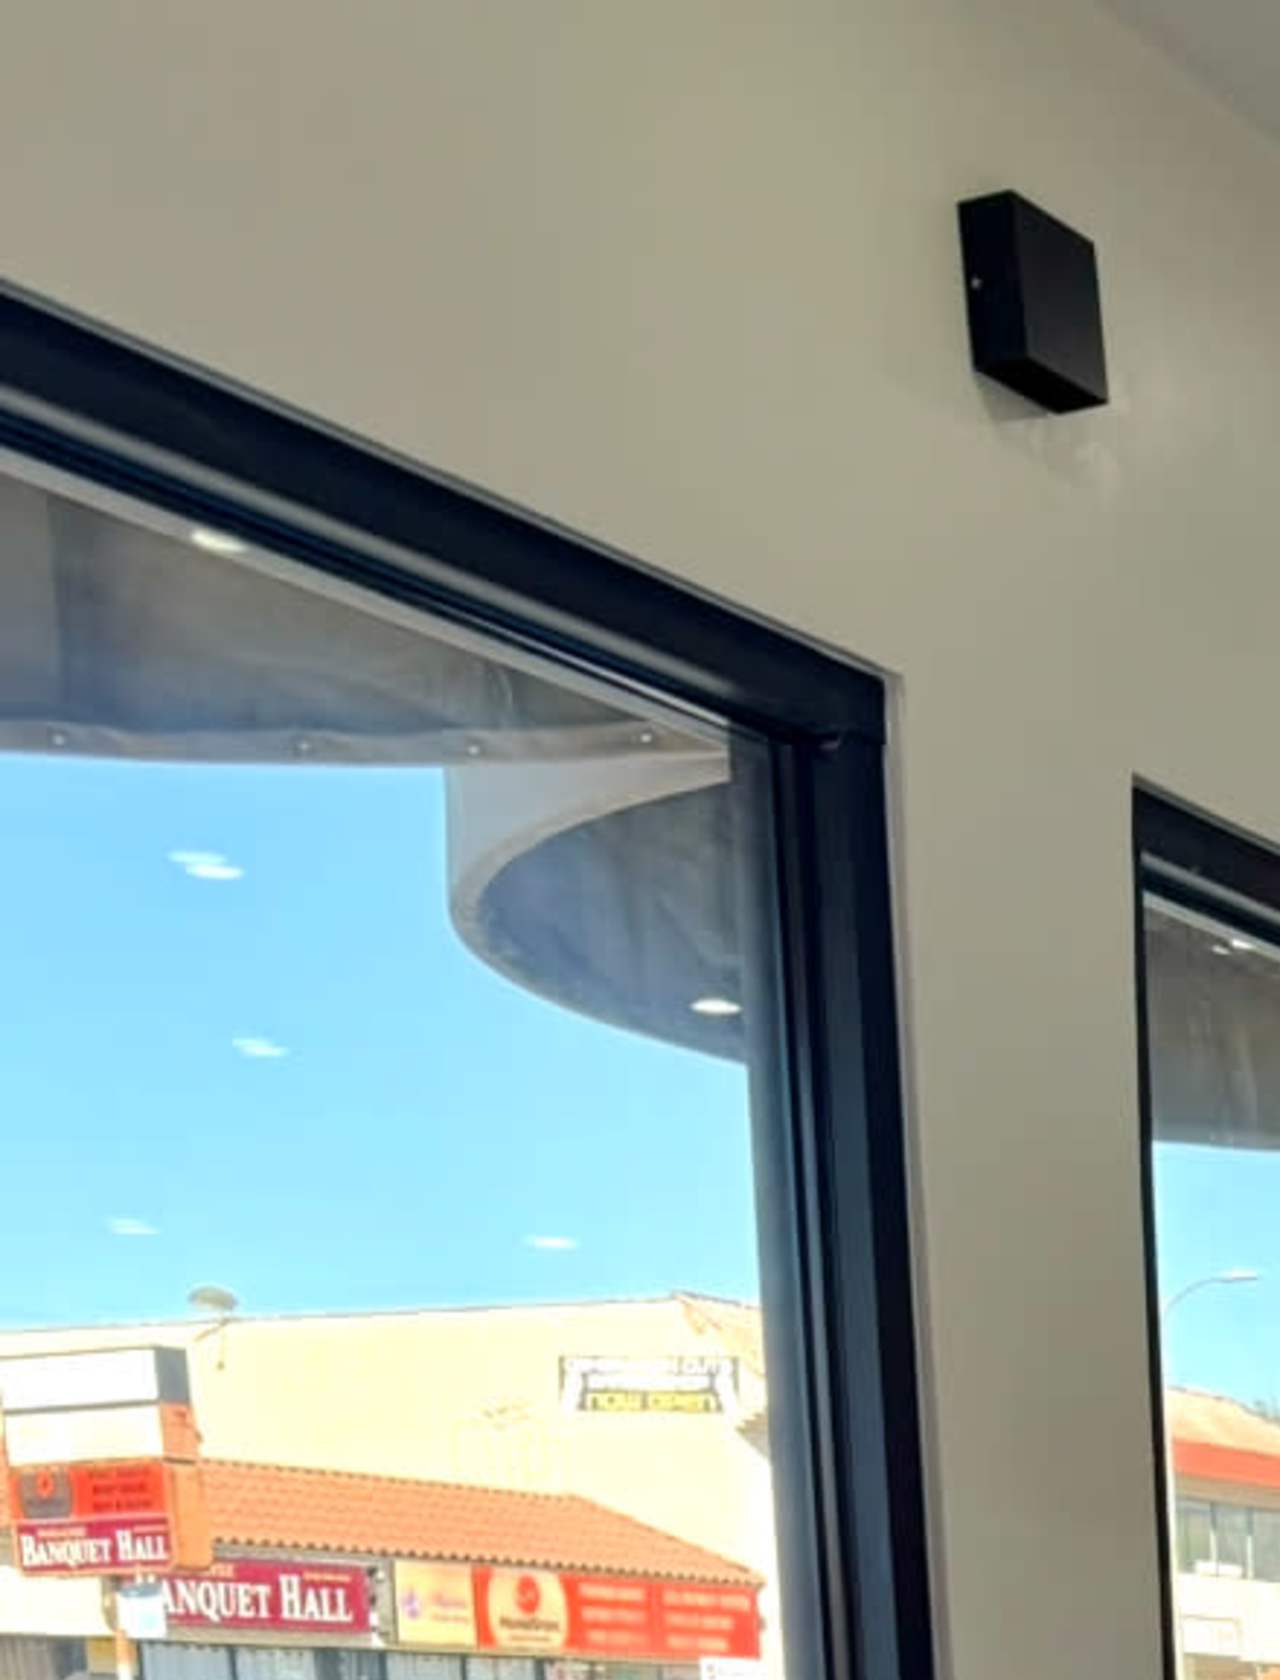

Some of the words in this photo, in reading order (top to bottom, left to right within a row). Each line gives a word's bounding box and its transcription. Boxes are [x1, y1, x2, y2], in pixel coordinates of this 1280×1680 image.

[20, 1535, 112, 1569] BANQUET
[116, 1529, 169, 1562] HALL
[136, 1572, 271, 1622] ANQUET
[279, 1573, 353, 1622] HALL
